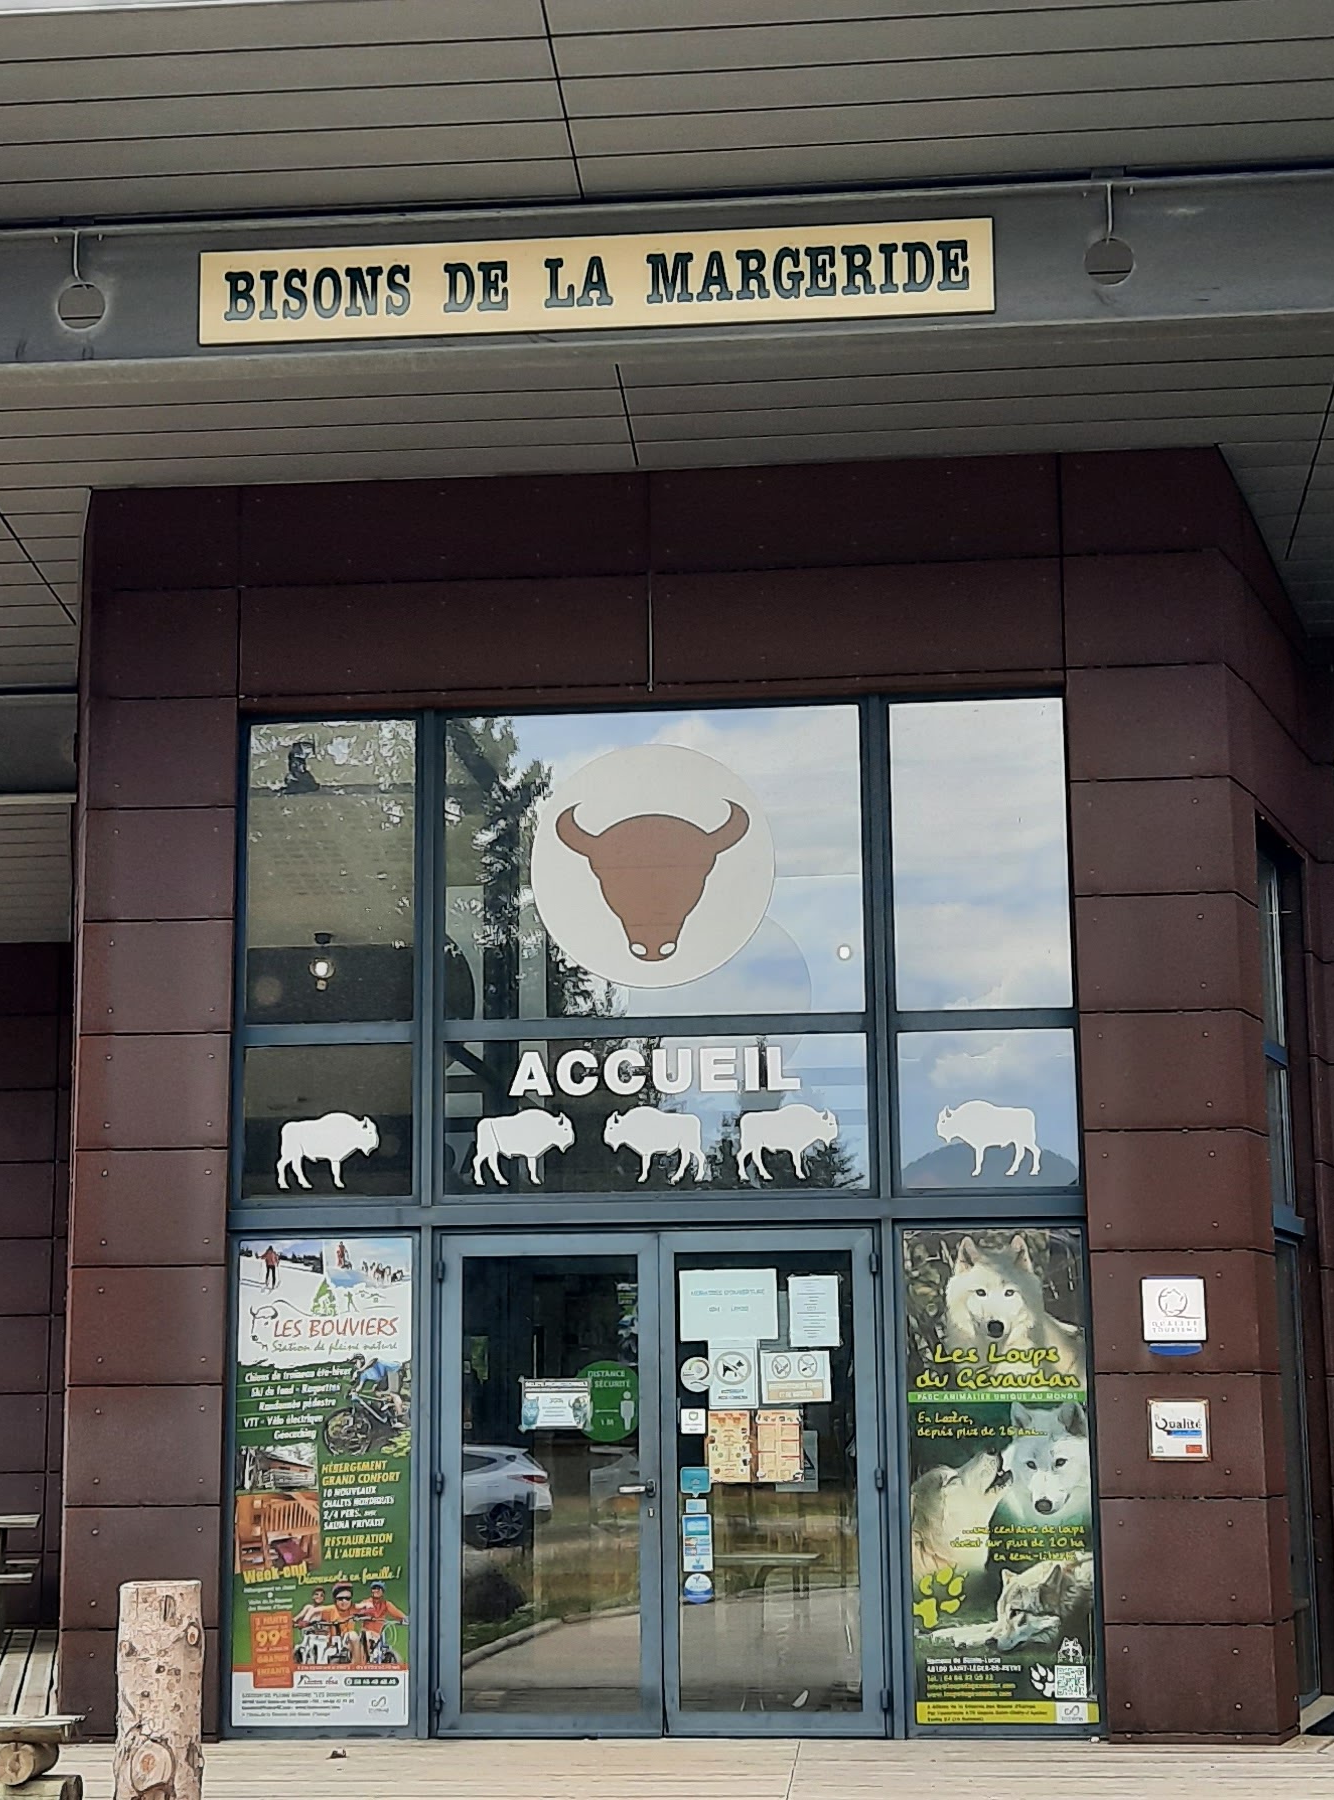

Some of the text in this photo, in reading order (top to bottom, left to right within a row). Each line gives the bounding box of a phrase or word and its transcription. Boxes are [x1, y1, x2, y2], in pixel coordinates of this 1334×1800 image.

[224, 239, 970, 322] BISONS DE LA MARGERIDE
[509, 1046, 801, 1098] ACCUEIL
[273, 1317, 399, 1338] LES BOUVIERS
[934, 1343, 1060, 1367] Les Loups
[588, 1370, 626, 1378] DISTANCE
[915, 1367, 1080, 1390] du Gévaudan
[917, 1393, 940, 1401] PARC
[1031, 1392, 1044, 1400] AU
[1047, 1392, 1078, 1400] MONDE
[244, 1417, 260, 1428] VTT
[917, 1411, 932, 1424] En
[917, 1426, 954, 1439] depuis
[956, 1426, 979, 1439] plus
[981, 1425, 996, 1436] de
[322, 1472, 401, 1487] GRAND CONFORT
[1041, 1524, 1056, 1534] de
[324, 1533, 394, 1547] RESTAURATION
[1031, 1538, 1045, 1547] de
[243, 1562, 307, 1585] Week-end
